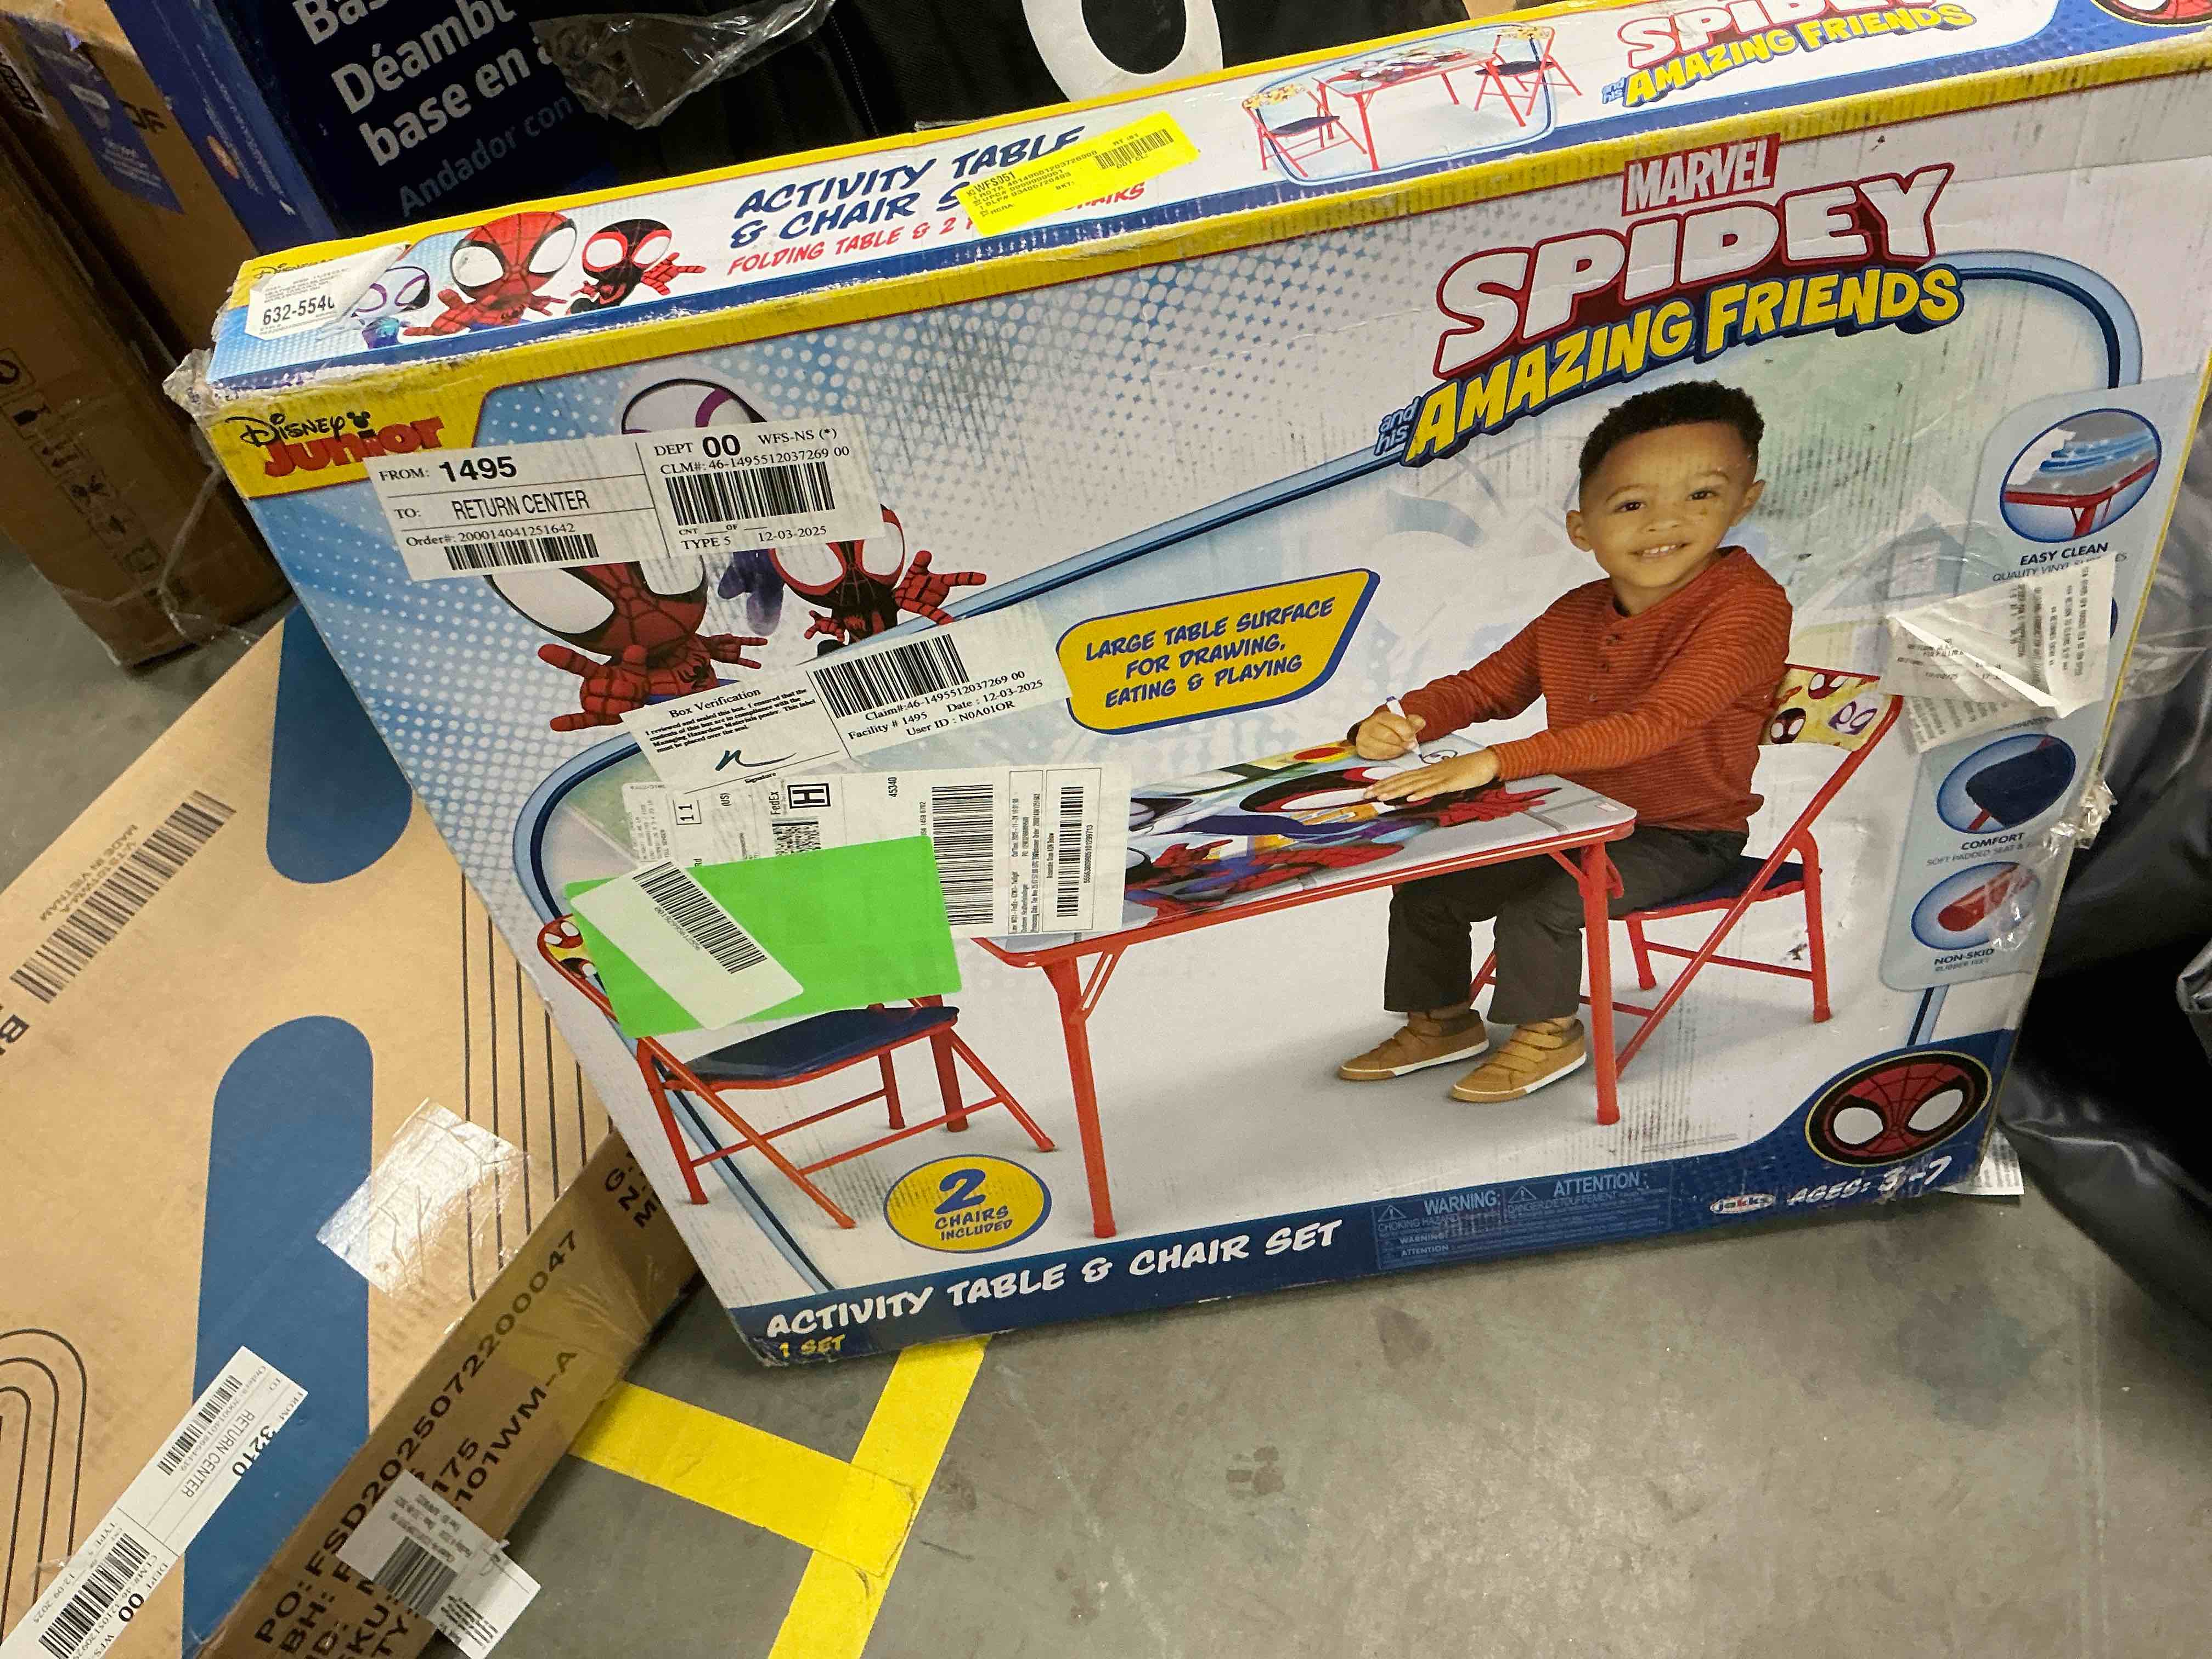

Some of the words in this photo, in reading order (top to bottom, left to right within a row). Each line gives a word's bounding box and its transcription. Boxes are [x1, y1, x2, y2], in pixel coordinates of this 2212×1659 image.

[1617, 0, 1937, 69] SPID
[1624, 29, 1799, 107] AMAZING
[1799, 3, 1976, 52] FRIENDS
[359, 83, 472, 166] base
[475, 47, 531, 98] en
[398, 126, 516, 217] Andador
[524, 95, 574, 138] con
[734, 158, 936, 219] ACTIVITY
[1626, 139, 1775, 212] MARVEL
[730, 219, 764, 249] &
[778, 190, 921, 239] CHAIR
[728, 242, 825, 275] FOLDING
[836, 229, 901, 255] TABLE
[911, 221, 930, 240] &
[939, 218, 957, 236] 2
[1432, 163, 1955, 379] SPIDEY
[1401, 300, 1695, 466] AMAZING
[1696, 264, 1965, 364] FRIENDS
[1379, 399, 1420, 435] and
[654, 442, 695, 456] DEPT
[701, 433, 741, 459] 00
[758, 429, 815, 445] WFS-NS
[1374, 425, 1409, 456] his
[379, 466, 430, 482] FROM:
[438, 455, 517, 483] 1495
[660, 460, 708, 475] CLM#:
[708, 448, 830, 470] 46-1495512037269
[833, 445, 850, 458] 00
[394, 506, 421, 520] TO:
[451, 494, 521, 521] RETURN
[522, 488, 590, 515] CENTER
[405, 532, 456, 548] Order#:
[459, 522, 575, 543] 200014041251642
[678, 527, 698, 536] CNT
[680, 536, 721, 550] TYPE
[723, 535, 731, 545] 5
[757, 525, 827, 543] 12-03-2025
[2018, 549, 2057, 567] EASY
[2059, 539, 2109, 560] CLEAN
[1991, 566, 2038, 584] QUALITY
[1086, 631, 1156, 661] LARGE
[1165, 617, 1229, 647] TABLE
[1236, 597, 1336, 631] SURFACE
[1126, 654, 1170, 681] FOR
[1180, 634, 1286, 668] DRAWING,
[1010, 669, 1026, 681] 00
[1105, 678, 1176, 708] EATING
[1187, 675, 1204, 692] &
[1215, 654, 1304, 686] PLAYING
[648, 729, 678, 741] contents
[686, 723, 700, 732] this
[700, 719, 713, 728] box
[774, 699, 789, 709] with
[789, 696, 801, 704] the
[650, 721, 680, 734] reviewed
[681, 717, 695, 726] and
[696, 712, 717, 723] sealed
[716, 708, 731, 717] this
[731, 704, 746, 713] box.
[753, 695, 781, 707] ensured
[781, 690, 795, 699] that
[795, 687, 807, 695] the
[668, 705, 692, 719] Box
[693, 687, 762, 712] Verification
[783, 703, 799, 712] This
[799, 697, 816, 708] label
[847, 720, 891, 742] Facility
[891, 719, 900, 729] #
[901, 710, 929, 726] 1495
[946, 697, 974, 714] Date
[982, 678, 1045, 704] 12-03-2025
[656, 743, 675, 753] must
[683, 734, 707, 747] placed
[706, 731, 722, 740] over
[722, 727, 734, 736] the
[905, 721, 932, 738] User
[933, 715, 951, 730] ID
[743, 770, 777, 785] Signature
[886, 776, 899, 798] 45340
[719, 792, 731, 806] (US)
[768, 790, 782, 815] FedEx
[1960, 831, 2025, 851] COMFORT
[1933, 948, 1995, 966] NON-SKID
[934, 1169, 989, 1214] 2
[1550, 1167, 1642, 1200] ATTENTION
[1784, 1176, 1873, 1209] AGES:
[934, 1206, 1010, 1232] CHAIRS
[1423, 1188, 1502, 1217] WARNING:
[940, 1218, 1014, 1243] INCLUDED
[766, 1288, 935, 1340] ACTIVITY
[947, 1263, 1068, 1308] TABLE
[1082, 1257, 1110, 1285] &
[1129, 1233, 1250, 1277] CHAIR
[1265, 1219, 1344, 1254] SET
[780, 1341, 791, 1358] 1
[800, 1334, 847, 1357] SET
[213, 1407, 256, 1455] RETURN
[179, 1450, 222, 1499] CENTER
[255, 1581, 312, 1643] PO:
[279, 1592, 336, 1654] BH:
